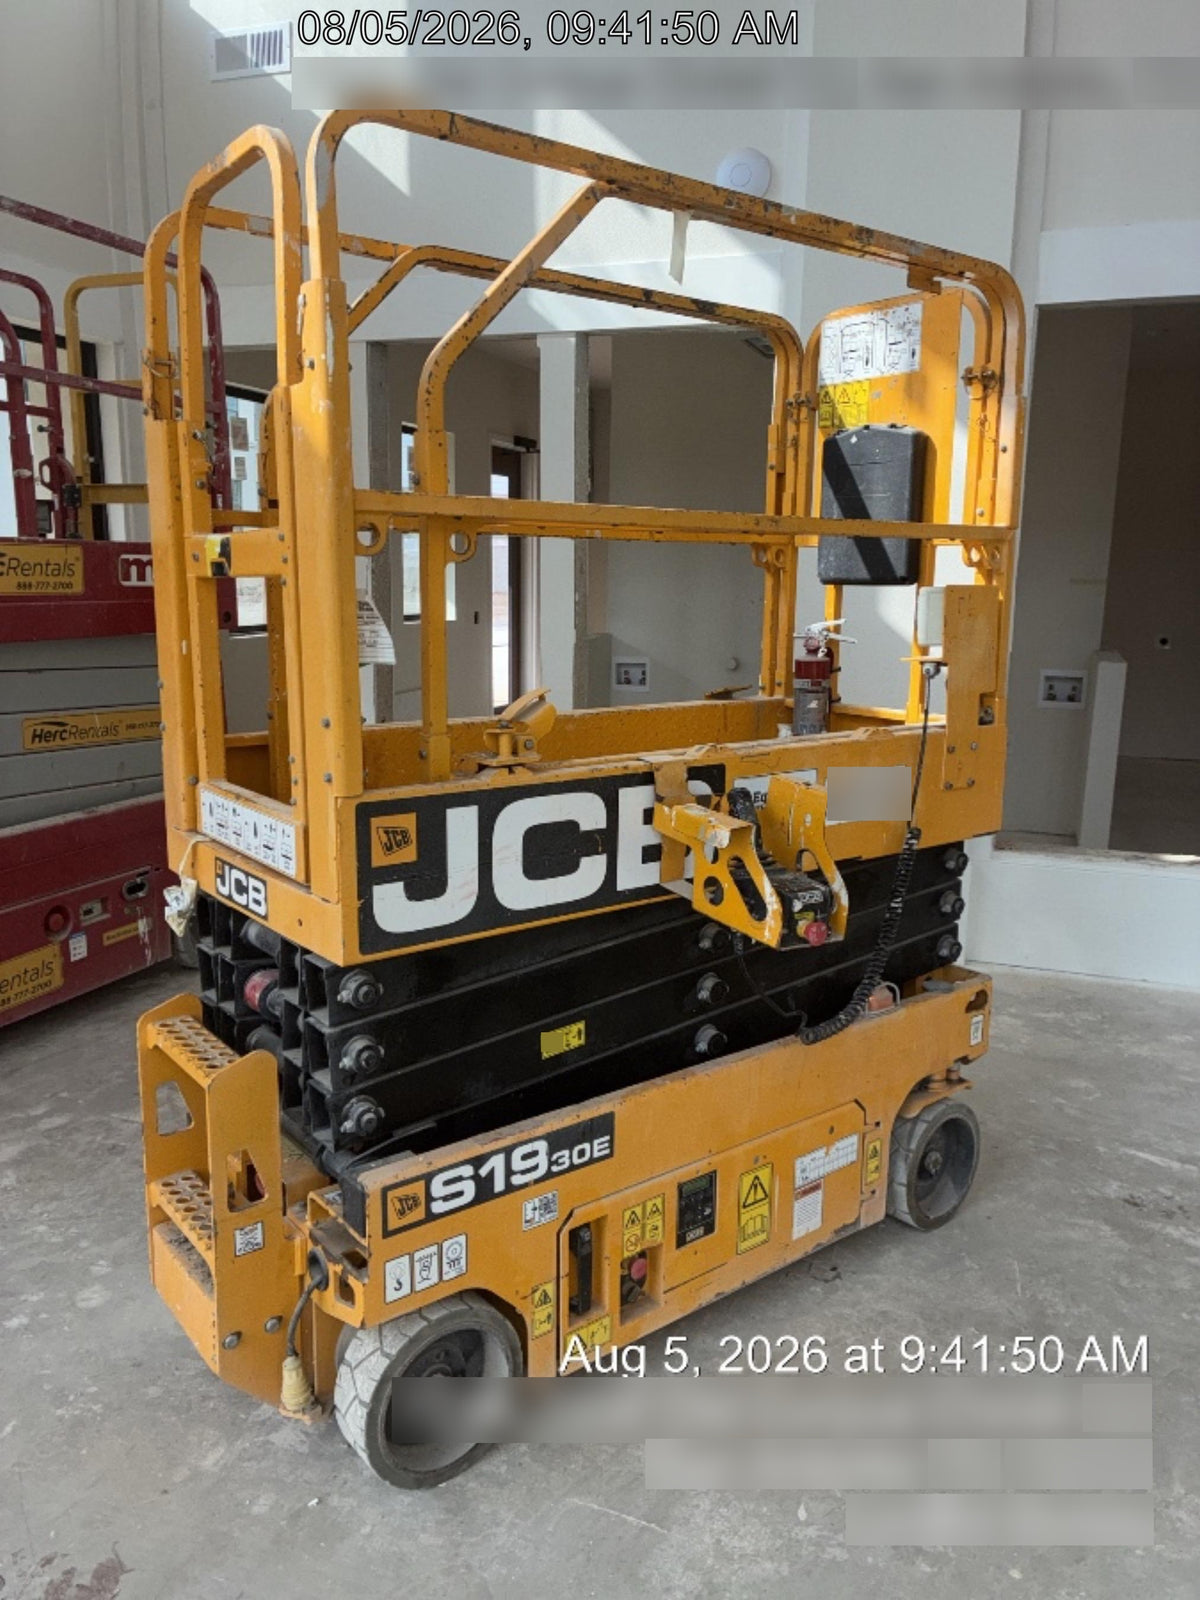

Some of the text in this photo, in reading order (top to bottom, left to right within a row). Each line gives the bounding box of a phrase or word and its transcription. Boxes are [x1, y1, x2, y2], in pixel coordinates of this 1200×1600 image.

[16, 581, 73, 591] 888-777-2700
[31, 722, 119, 744] HercRentals
[382, 828, 411, 853] JCB
[216, 863, 267, 917] JCB
